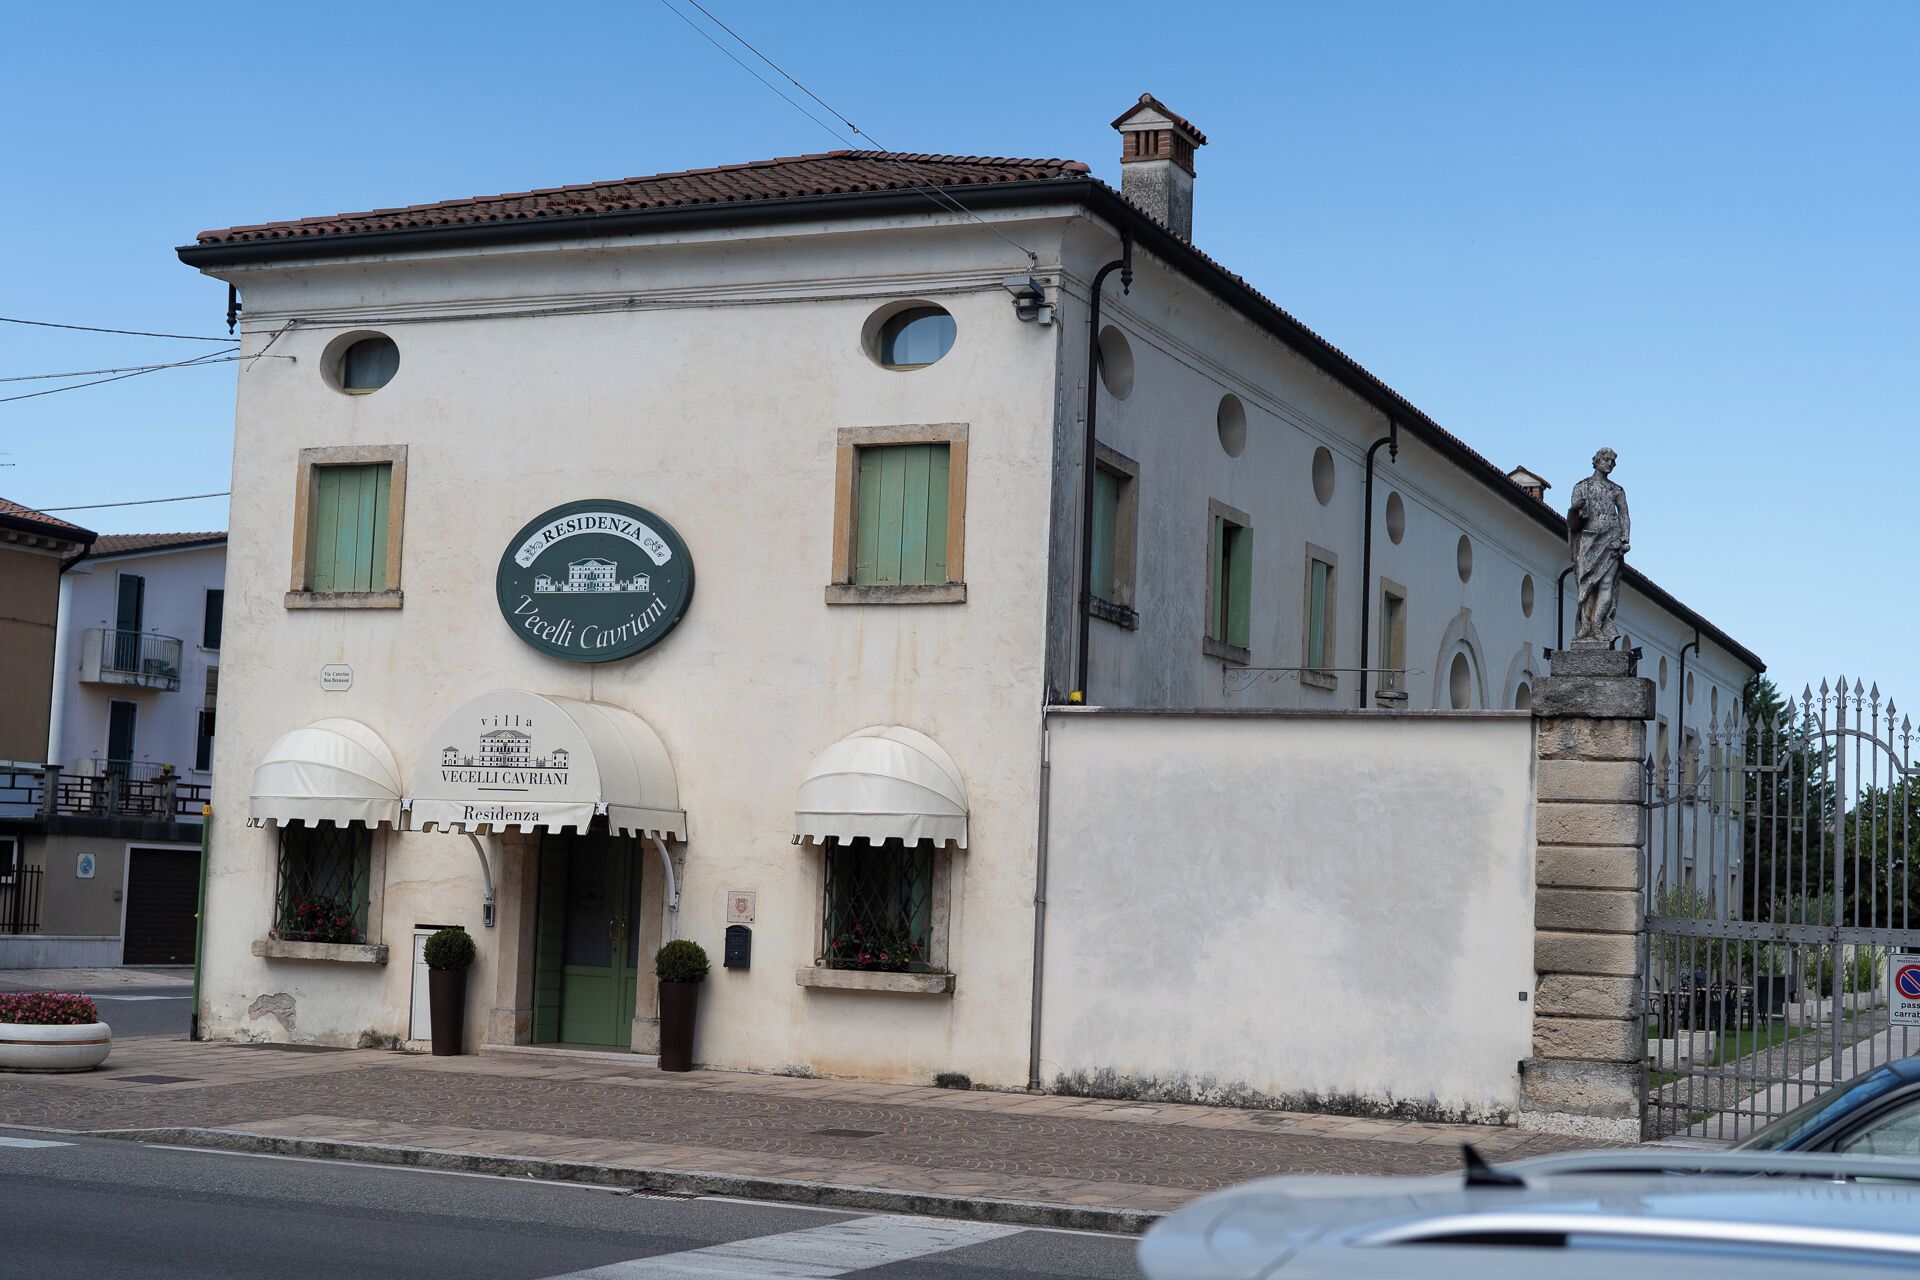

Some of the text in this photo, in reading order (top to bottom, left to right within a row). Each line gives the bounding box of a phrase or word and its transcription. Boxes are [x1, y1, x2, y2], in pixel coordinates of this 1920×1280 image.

[542, 516, 642, 544] RESIDENZA
[514, 592, 668, 649] Vecelli Cavriani
[441, 770, 569, 786] VECELLI CAVRIANI
[463, 805, 540, 822] Residenza
